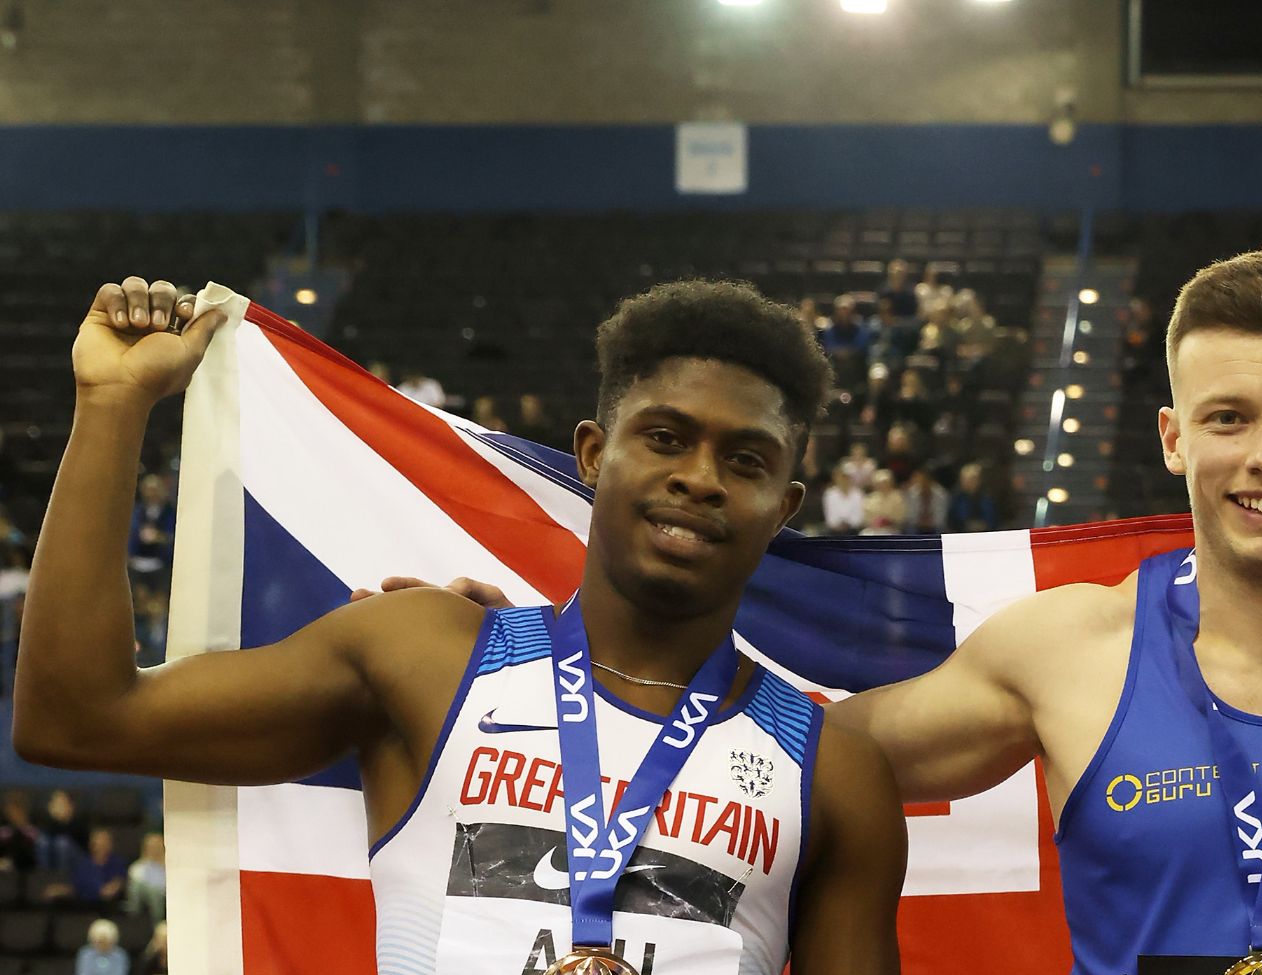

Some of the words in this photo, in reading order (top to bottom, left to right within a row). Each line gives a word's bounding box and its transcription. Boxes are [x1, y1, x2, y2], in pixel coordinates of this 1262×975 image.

[558, 650, 589, 723] UKA
[662, 692, 719, 749] UKA
[590, 805, 651, 880] UKA
